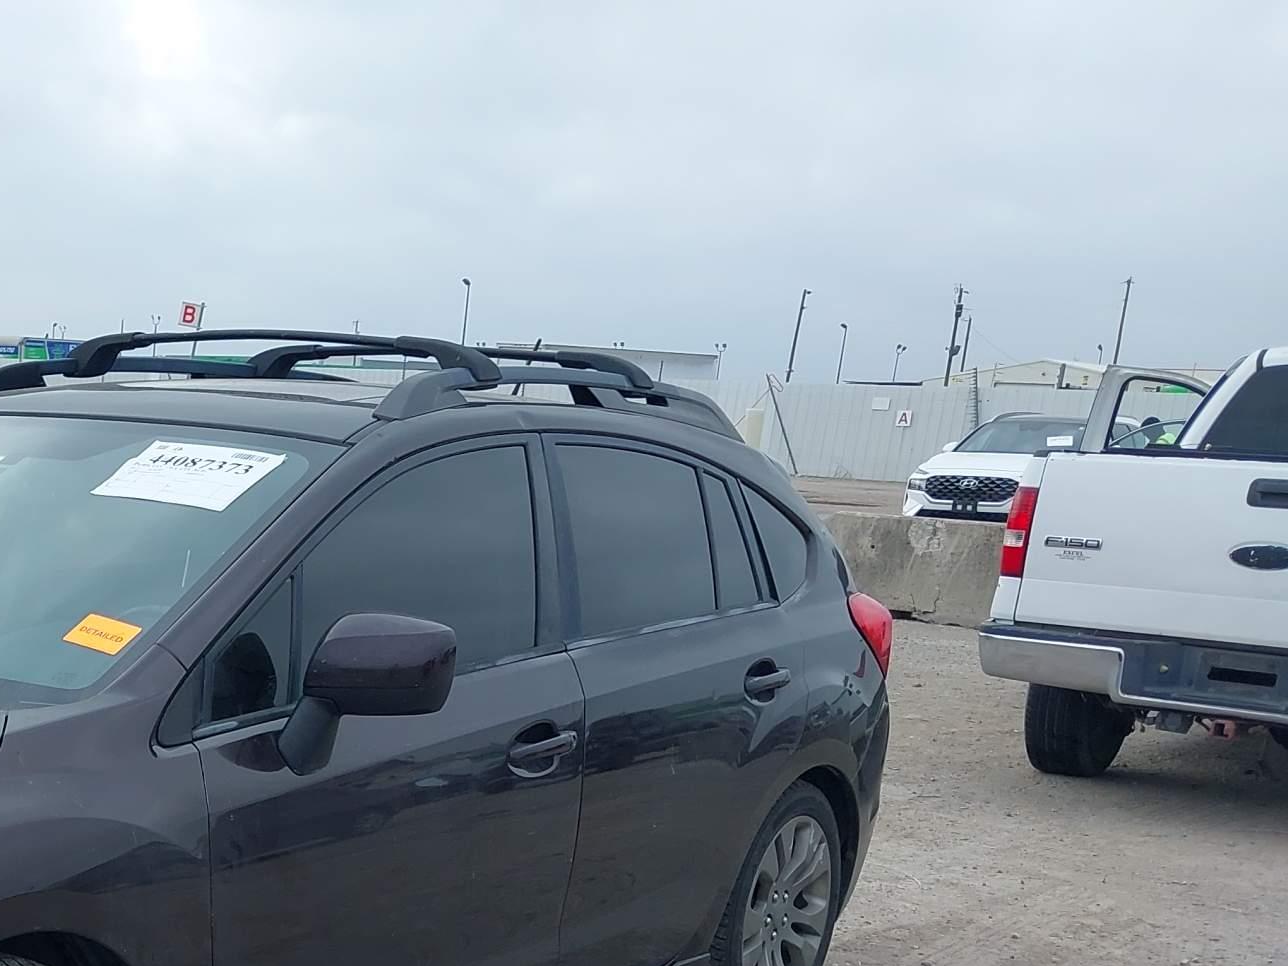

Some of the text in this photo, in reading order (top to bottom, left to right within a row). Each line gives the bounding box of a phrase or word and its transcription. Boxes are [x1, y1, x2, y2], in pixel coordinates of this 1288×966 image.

[182, 304, 196, 324] B
[897, 412, 908, 425] A
[149, 453, 254, 475] 44087373
[79, 625, 124, 643] DETAILED
